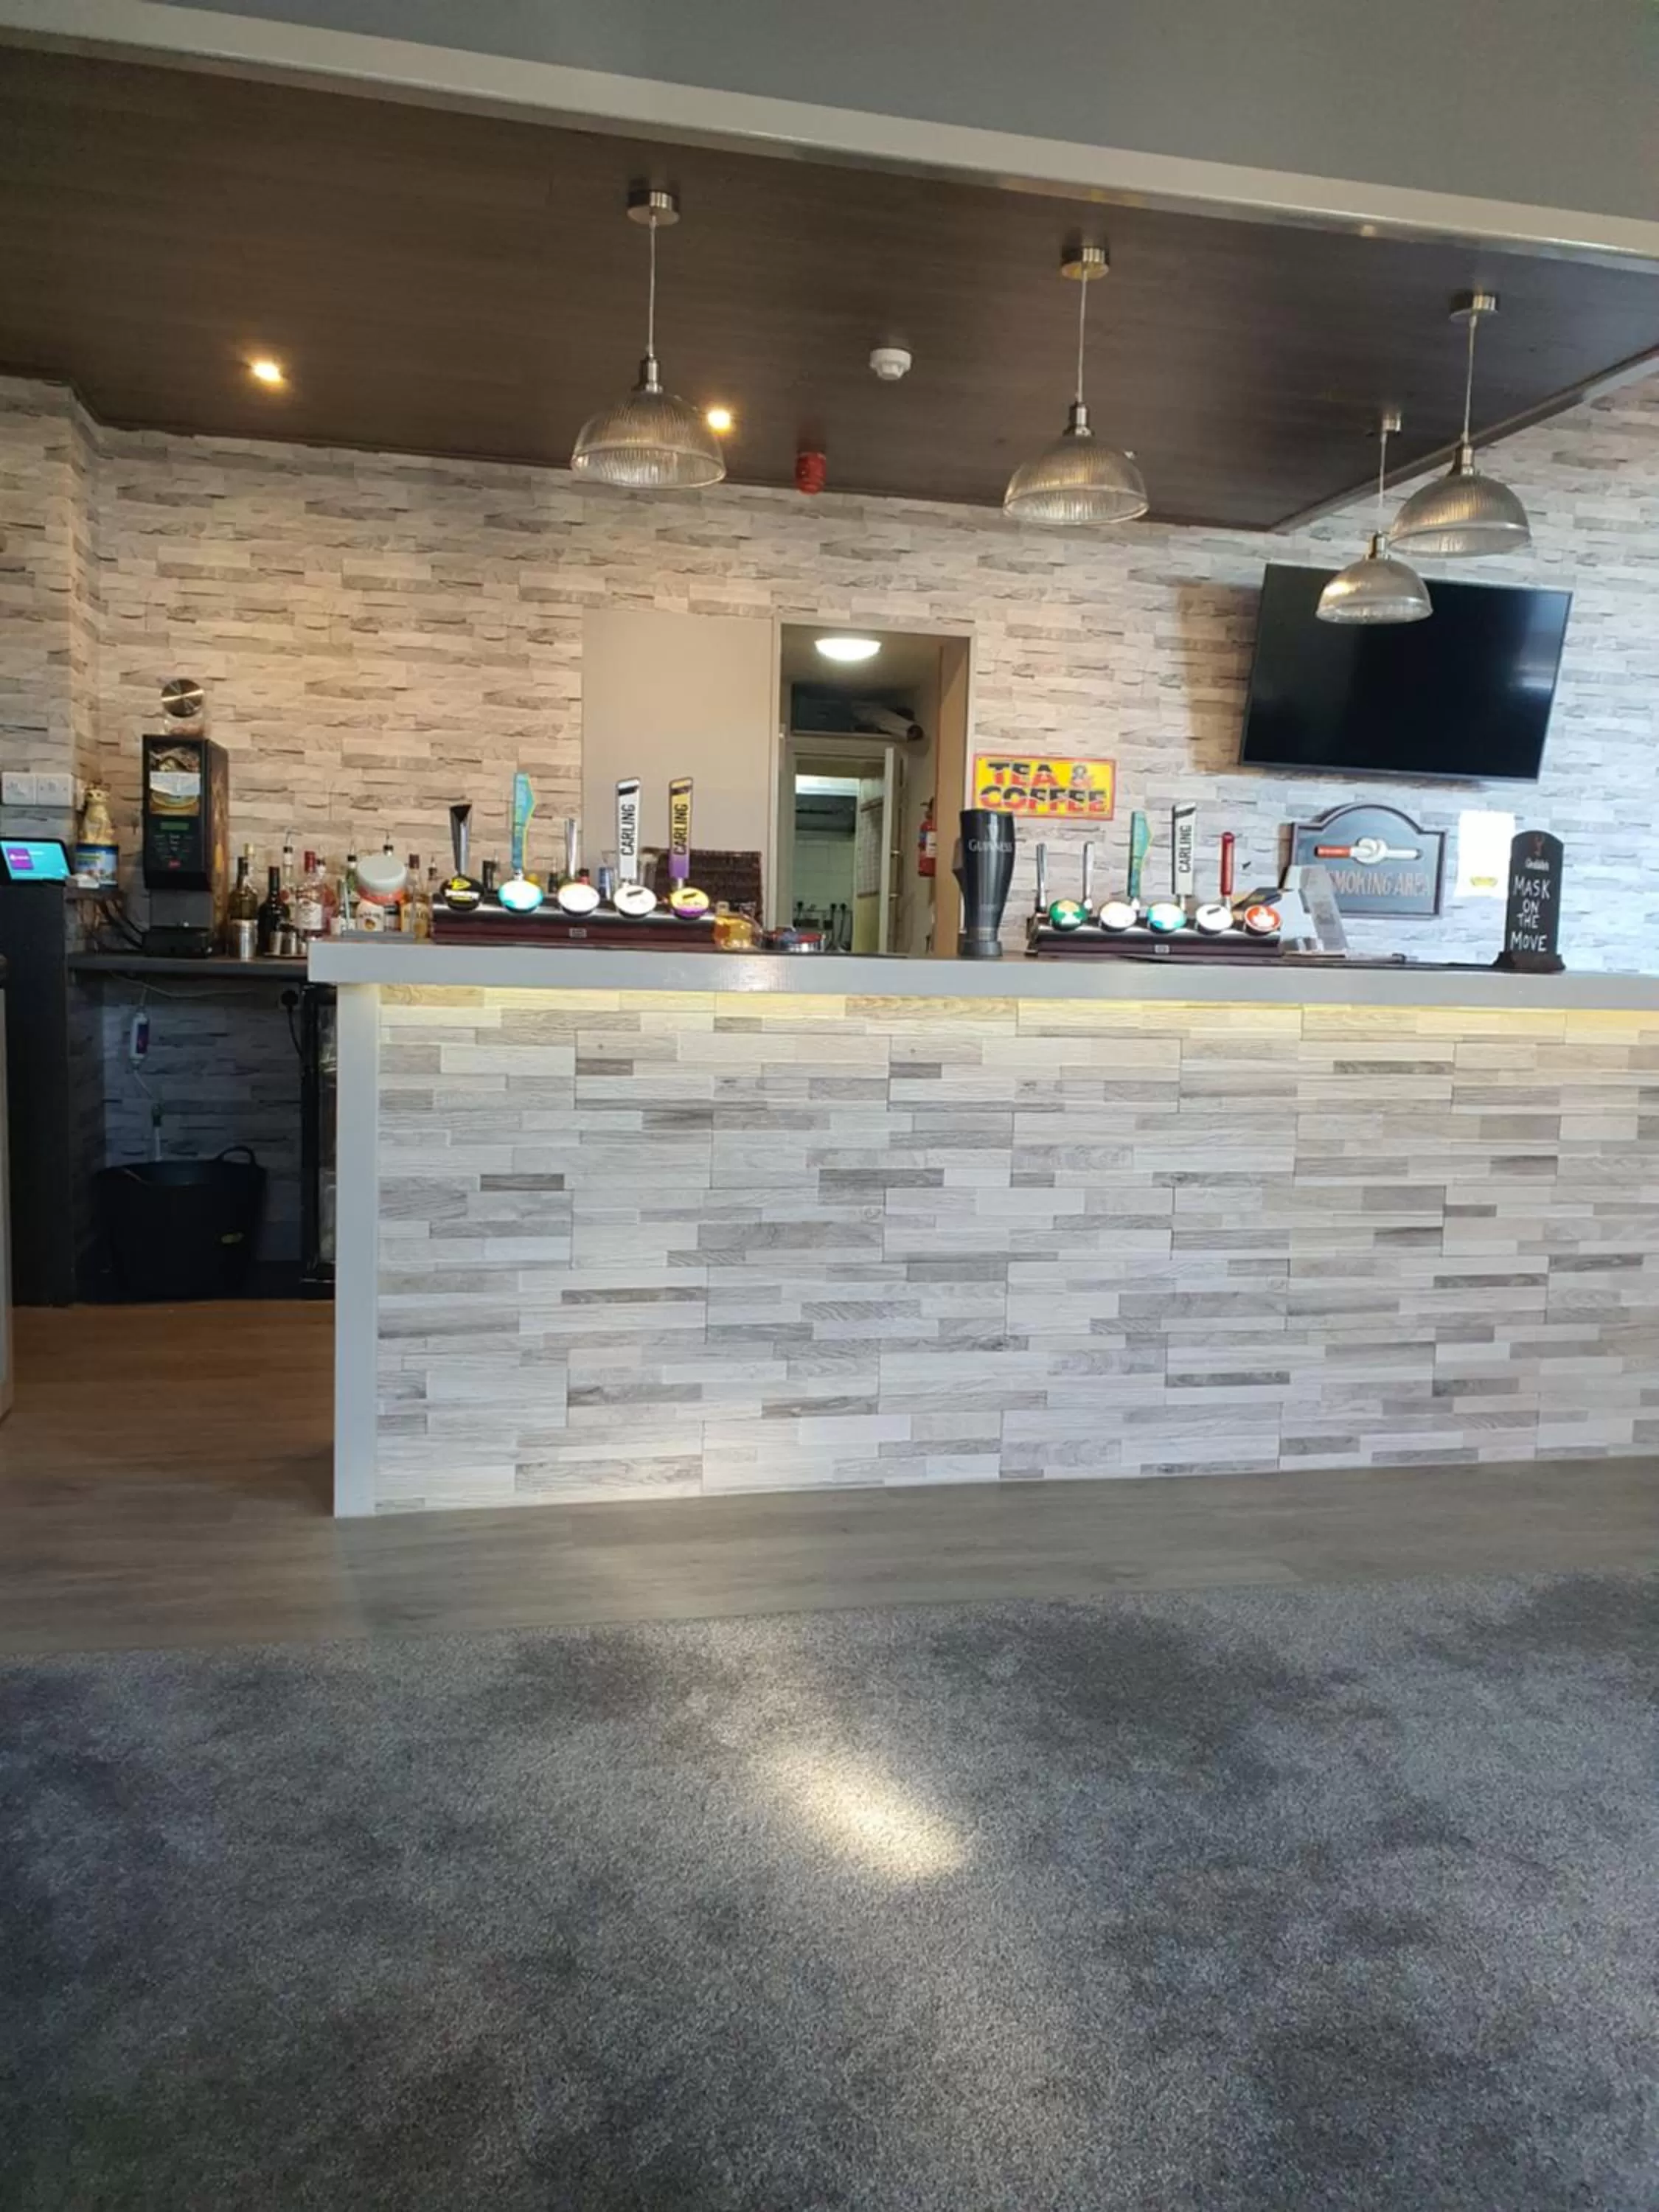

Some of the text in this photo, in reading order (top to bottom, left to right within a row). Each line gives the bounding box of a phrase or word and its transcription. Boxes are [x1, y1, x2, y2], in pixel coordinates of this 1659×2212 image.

[988, 762, 1094, 789] TEA &
[980, 786, 1107, 813] COFFEE
[621, 804, 636, 856] CARLING
[674, 804, 688, 855] CARLING
[1178, 825, 1192, 873] CARLING
[1328, 869, 1434, 897] MOKING AREA
[1513, 875, 1551, 899] MASK
[1522, 899, 1540, 914] ON
[1517, 912, 1540, 929] THE
[1510, 930, 1548, 952] MOVE
